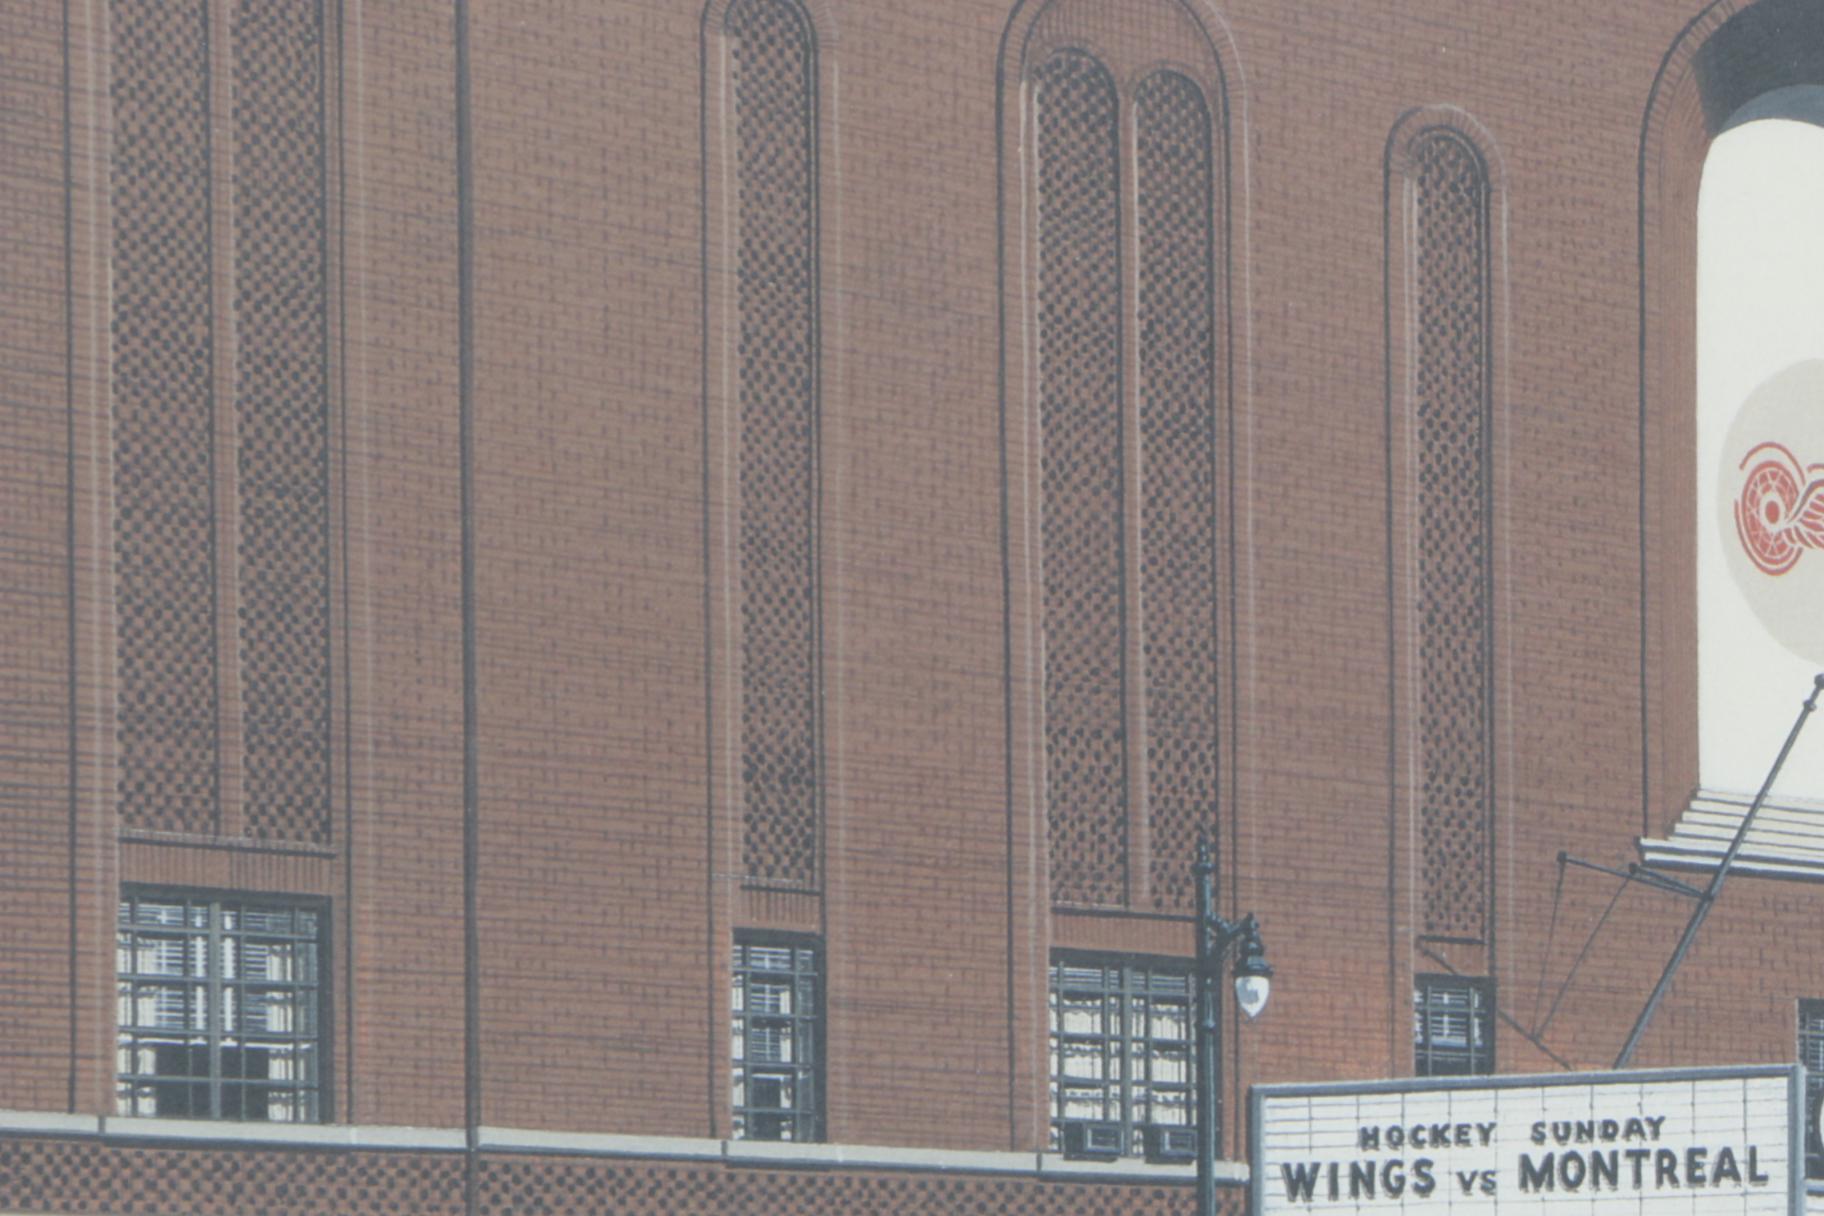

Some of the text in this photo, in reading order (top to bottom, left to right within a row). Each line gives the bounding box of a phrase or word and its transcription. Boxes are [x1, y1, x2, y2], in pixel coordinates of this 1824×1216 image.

[1359, 1116, 1667, 1150] HOCKEY SUNDAY
[1282, 1159, 1437, 1201] WINGS
[1519, 1145, 1769, 1193] MONTREAL
